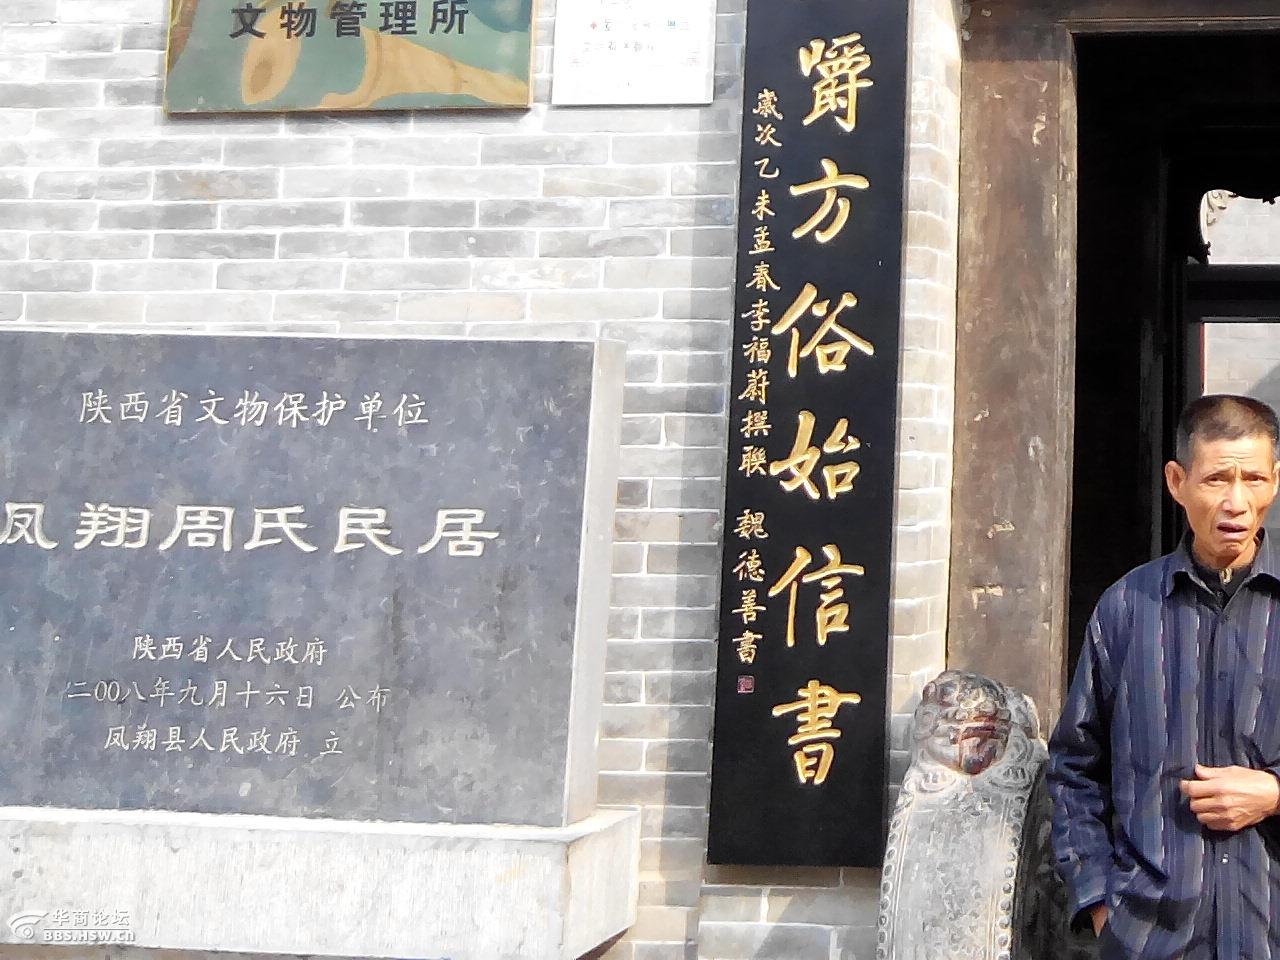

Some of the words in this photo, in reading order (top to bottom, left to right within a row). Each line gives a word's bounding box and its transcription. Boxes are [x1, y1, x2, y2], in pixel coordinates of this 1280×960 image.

[78, 389, 431, 430] 陕西省文物保护单位
[0, 501, 500, 559] 凤翔周氏民居
[131, 635, 329, 666] 陕西省人民政府
[335, 683, 392, 712] 公布
[104, 726, 302, 756] 凤翔县人民政府
[319, 729, 345, 756] 立
